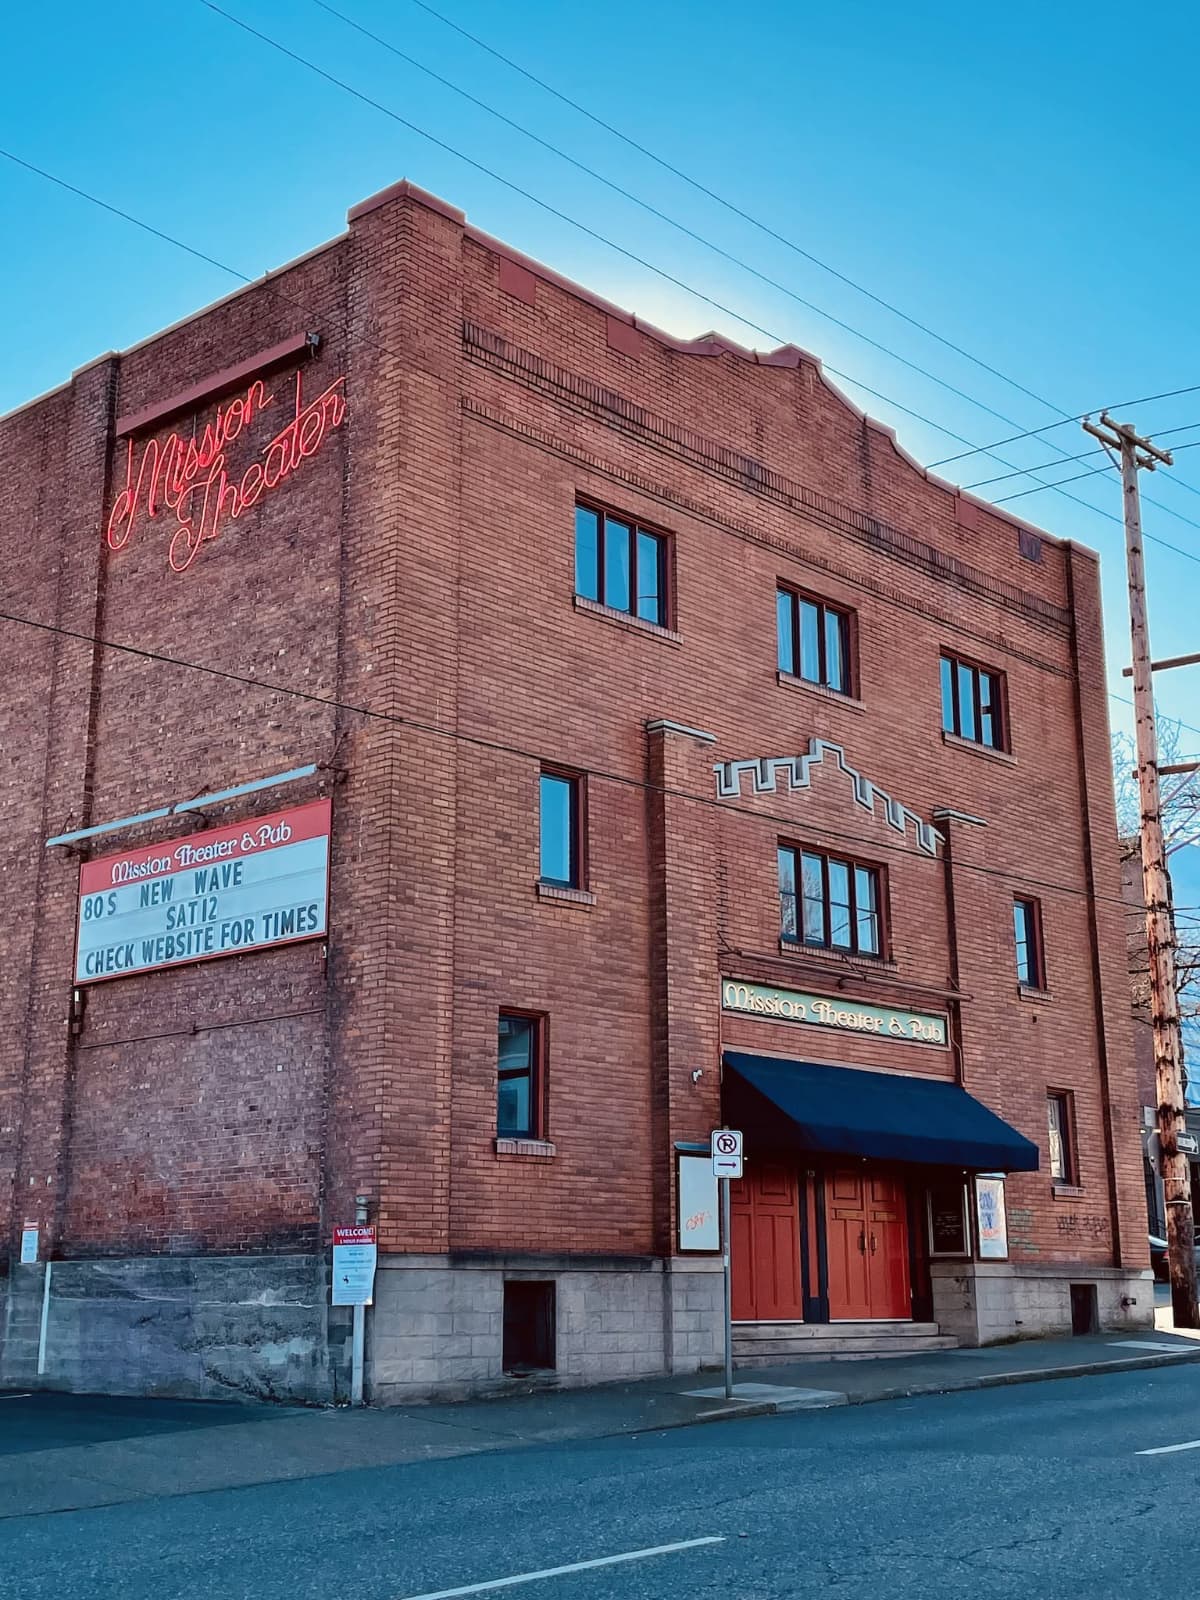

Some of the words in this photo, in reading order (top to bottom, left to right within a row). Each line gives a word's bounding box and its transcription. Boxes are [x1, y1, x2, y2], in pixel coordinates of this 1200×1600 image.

[108, 380, 273, 550] Mission
[169, 371, 346, 571] Theater
[111, 855, 172, 884] Mission
[174, 839, 237, 867] Theater
[240, 832, 257, 851] &
[256, 820, 292, 847] Pub
[84, 892, 117, 920] 80S
[140, 878, 173, 907] NEW
[194, 861, 243, 895] WAVE
[85, 943, 134, 975] CHECK
[142, 926, 213, 964] WEBSITE
[221, 918, 255, 948] FOR
[262, 904, 318, 939] TIMES
[725, 984, 806, 1019] Mission
[810, 1000, 883, 1033] Theater
[888, 1019, 905, 1036] &
[906, 1018, 942, 1043] Pub
